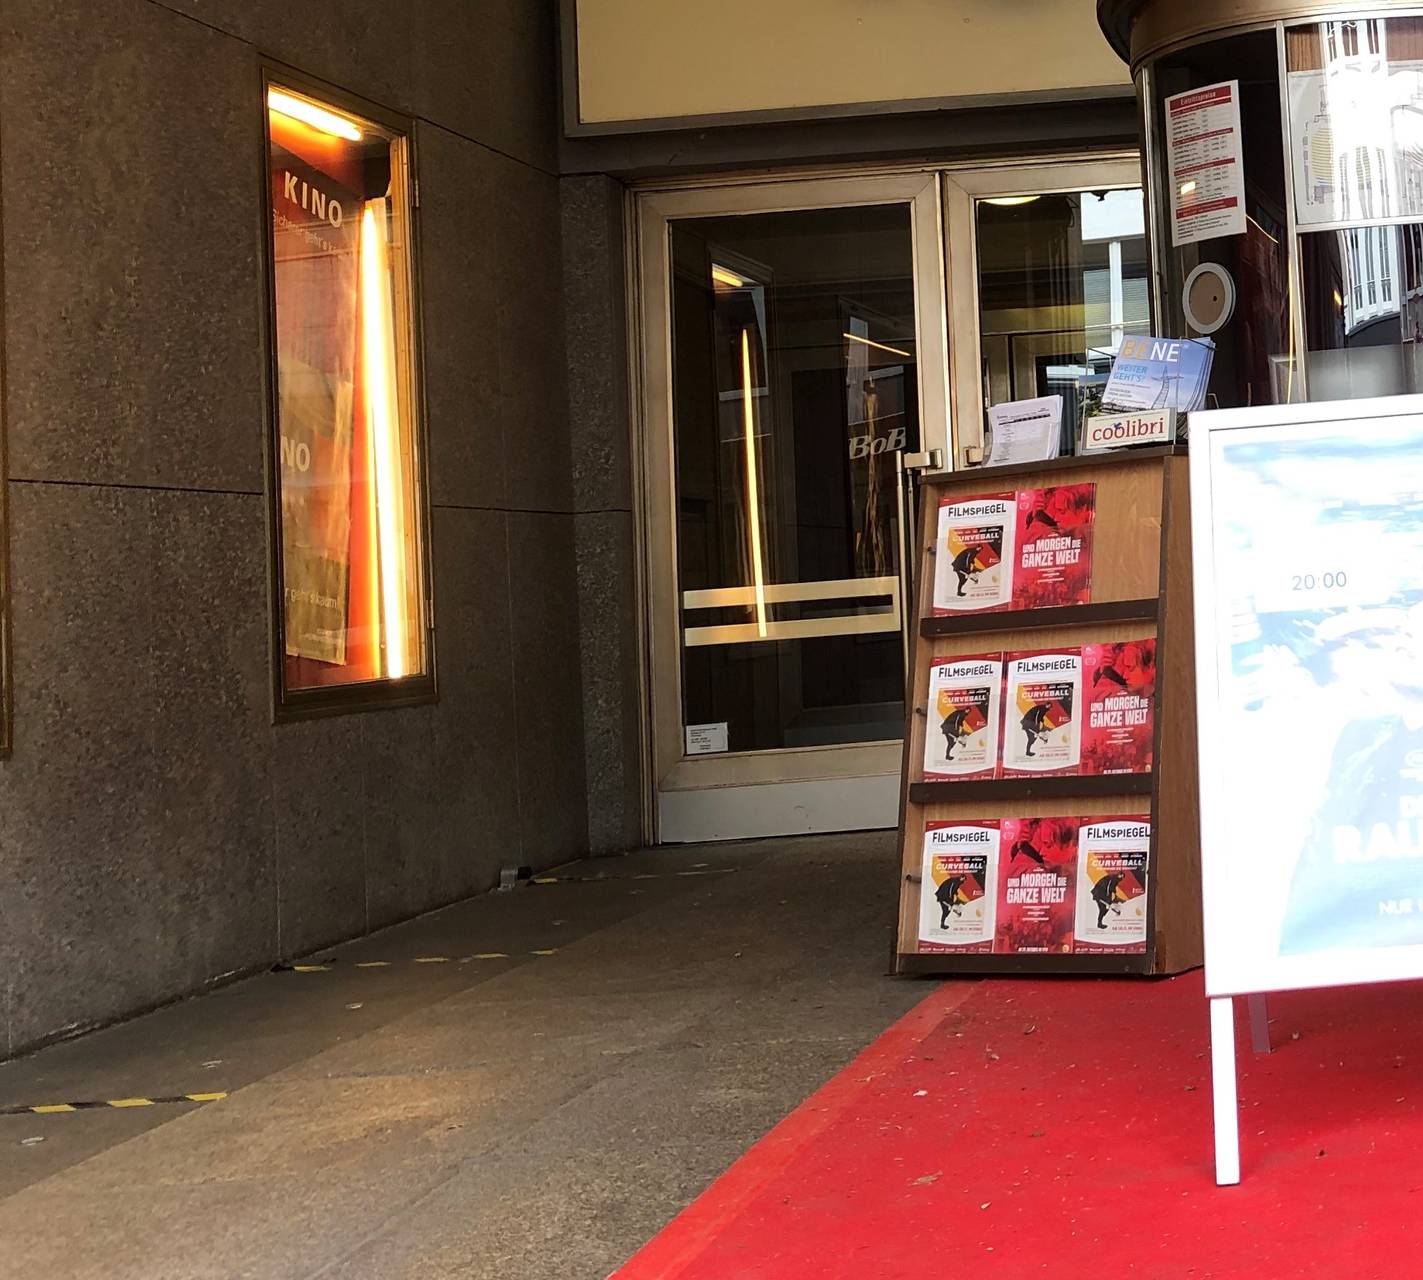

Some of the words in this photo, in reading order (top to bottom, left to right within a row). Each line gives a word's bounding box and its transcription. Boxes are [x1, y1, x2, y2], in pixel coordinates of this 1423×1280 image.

[284, 171, 343, 228] KINO
[1092, 417, 1164, 441] coolibri
[948, 503, 1007, 517] FILMSPIEGEL
[1036, 536, 1072, 553] MORGEN
[1022, 551, 1054, 568] GANZE
[1056, 549, 1081, 565] WELT
[1292, 571, 1347, 591] 20:00
[938, 664, 994, 678] FILMSPIEGEL
[1017, 658, 1077, 672] FILMSPIEGEL
[1104, 695, 1140, 711] MORGEN
[1090, 711, 1123, 728] GANZE
[1125, 709, 1149, 726] WELT
[932, 831, 990, 843] FILMSPIEGEL
[1087, 826, 1151, 839] FILMSPIEGEL
[936, 862, 983, 870] CURVEBALL
[1020, 873, 1057, 887] MORGEN
[1006, 887, 1039, 904] GANZE
[1041, 887, 1067, 903] WELT
